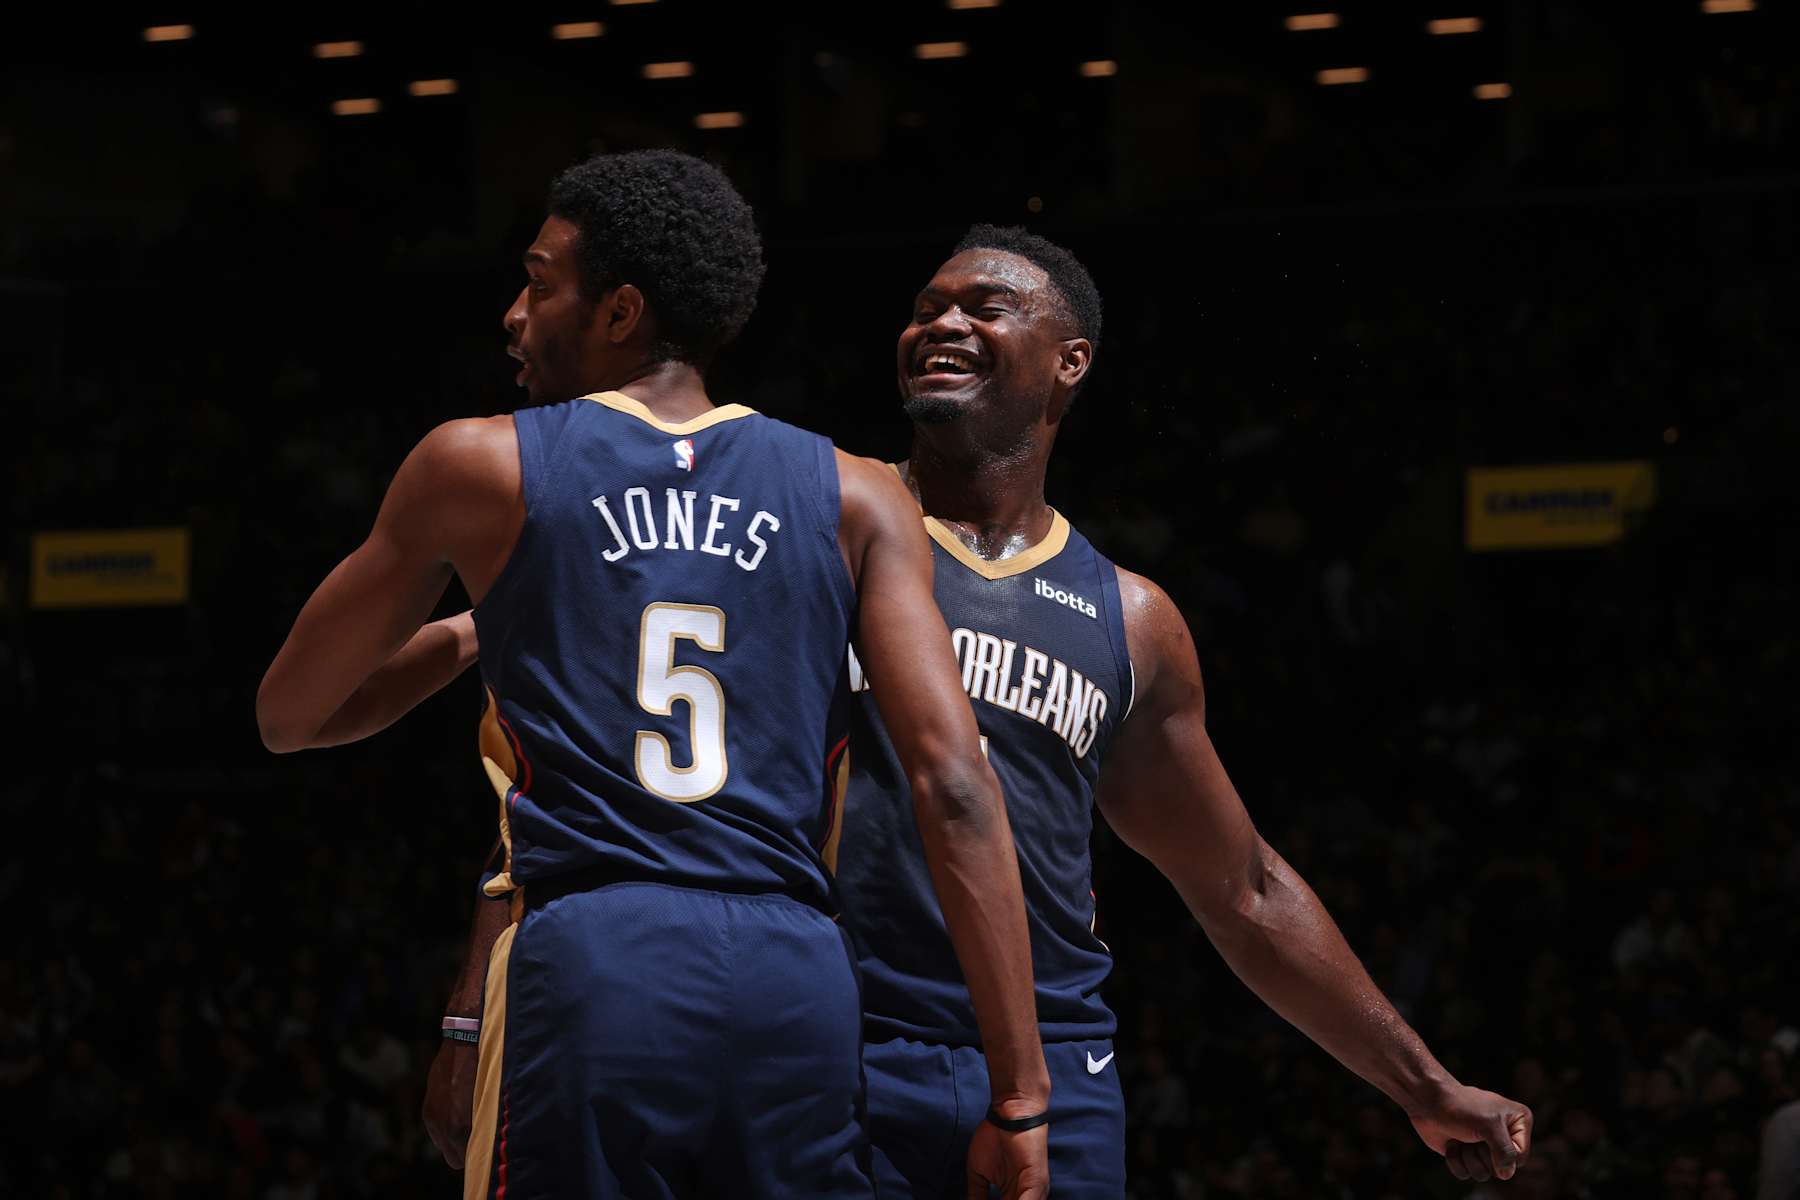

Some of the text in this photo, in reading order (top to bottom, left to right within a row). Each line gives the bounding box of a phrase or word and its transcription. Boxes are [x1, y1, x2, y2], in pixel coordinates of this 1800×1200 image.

[592, 486, 781, 571] JONES
[1034, 577, 1097, 619] ibotta
[634, 601, 729, 802] 5
[951, 627, 1108, 759] ORLEANS
